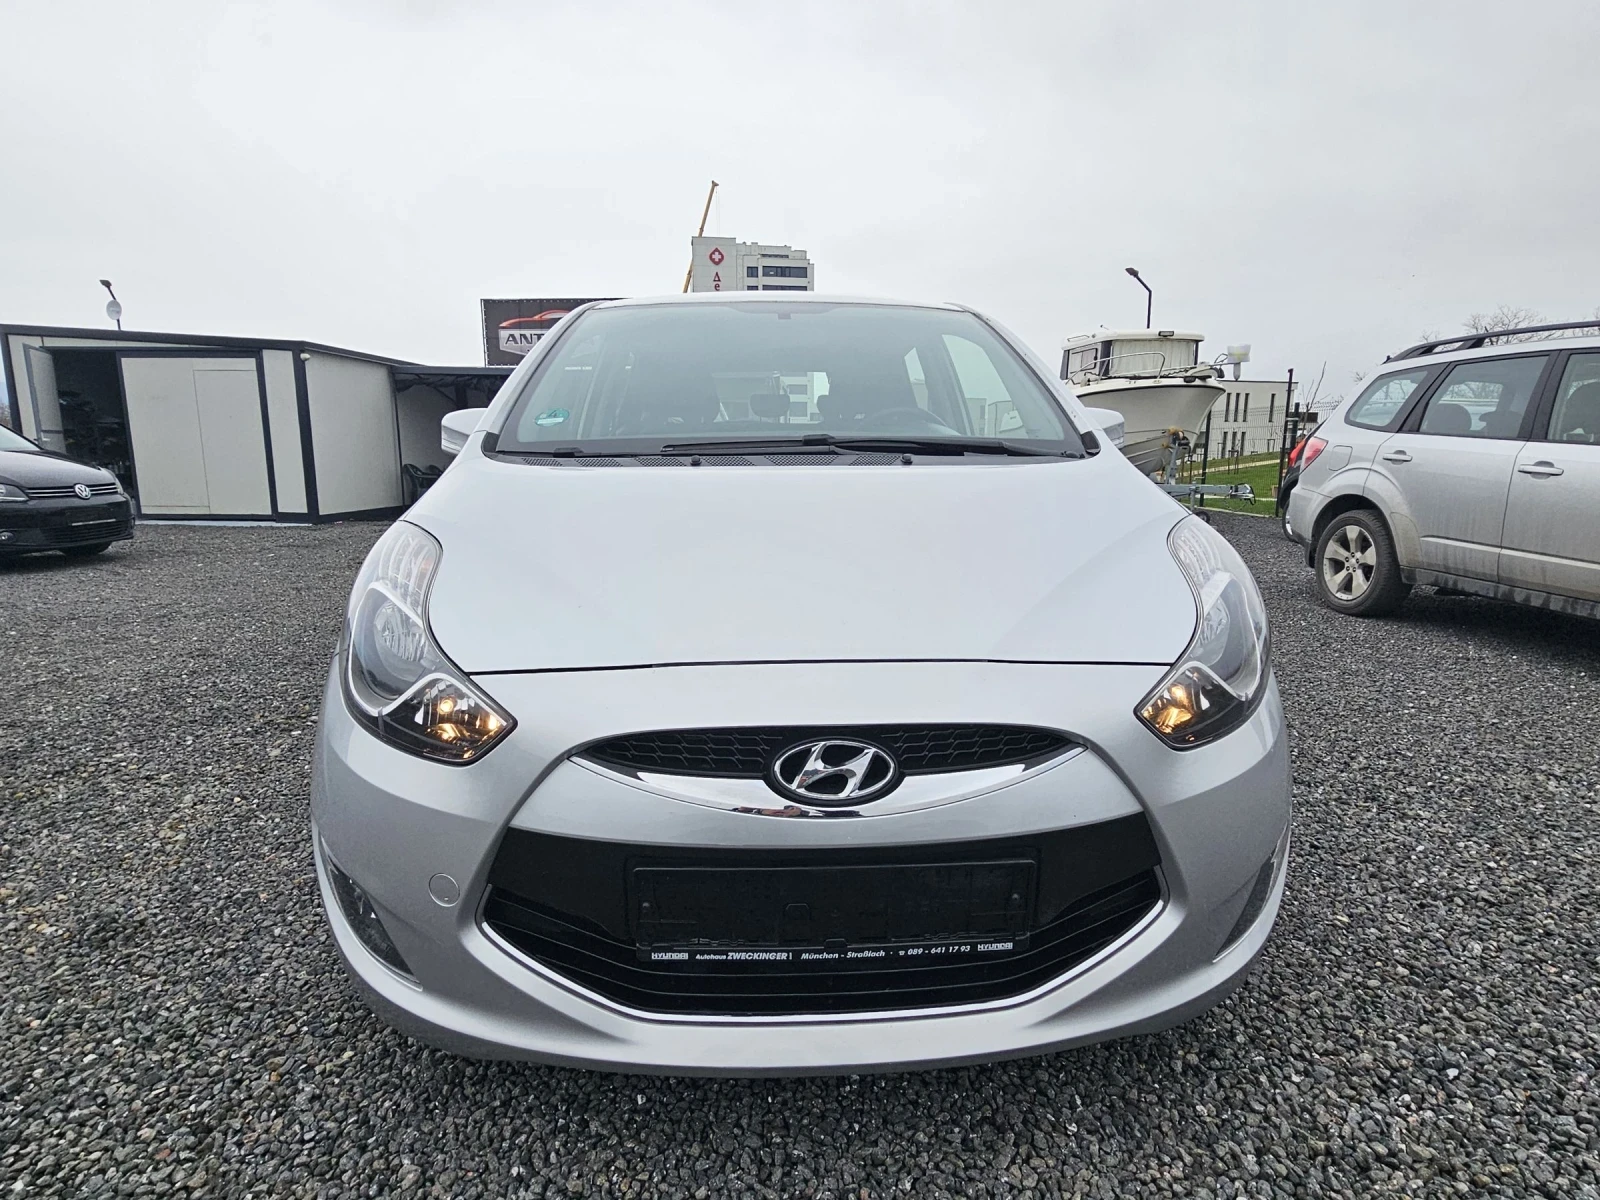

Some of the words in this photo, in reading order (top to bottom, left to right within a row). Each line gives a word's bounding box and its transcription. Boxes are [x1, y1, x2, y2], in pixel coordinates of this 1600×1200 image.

[651, 952, 689, 960] HYUNDAI
[800, 951, 839, 960] München
[846, 949, 886, 958] Straßlach
[930, 946, 945, 954] 641
[948, 945, 959, 953] 17
[977, 942, 1014, 952] HYUNDAI
